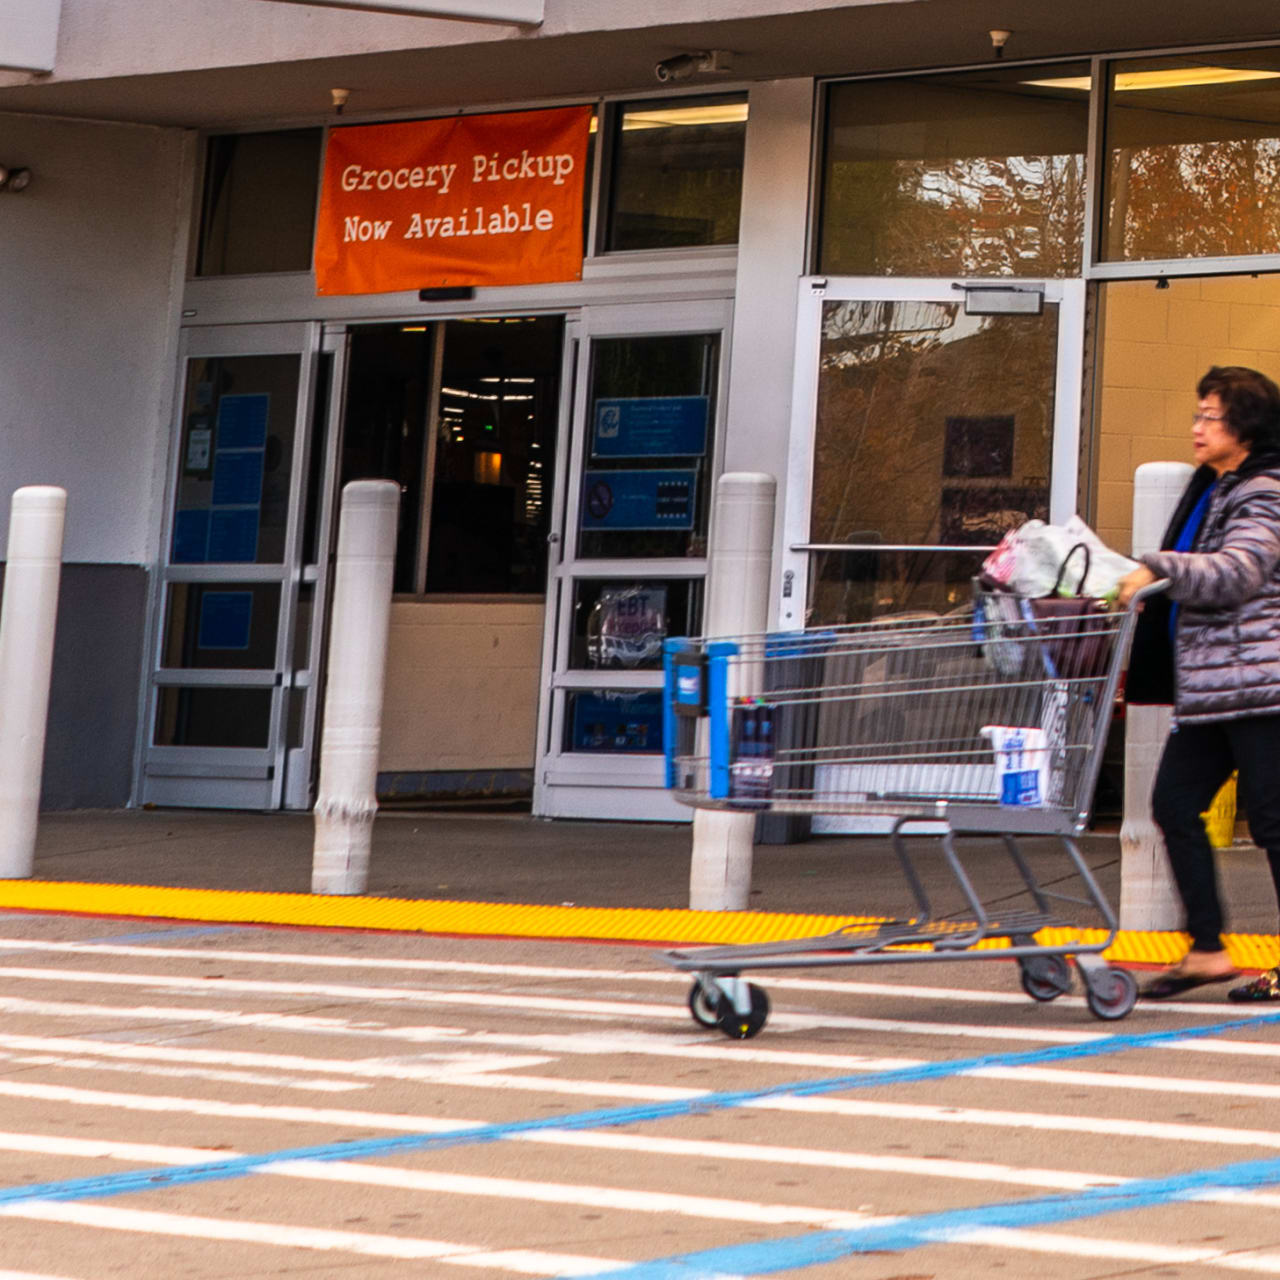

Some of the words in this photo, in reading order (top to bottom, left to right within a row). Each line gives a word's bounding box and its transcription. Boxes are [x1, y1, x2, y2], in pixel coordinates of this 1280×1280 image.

[341, 163, 457, 194] Grocery
[472, 150, 575, 186] Pickup
[344, 215, 392, 243] Now
[404, 203, 554, 240] Available
[617, 595, 648, 617] EBT
